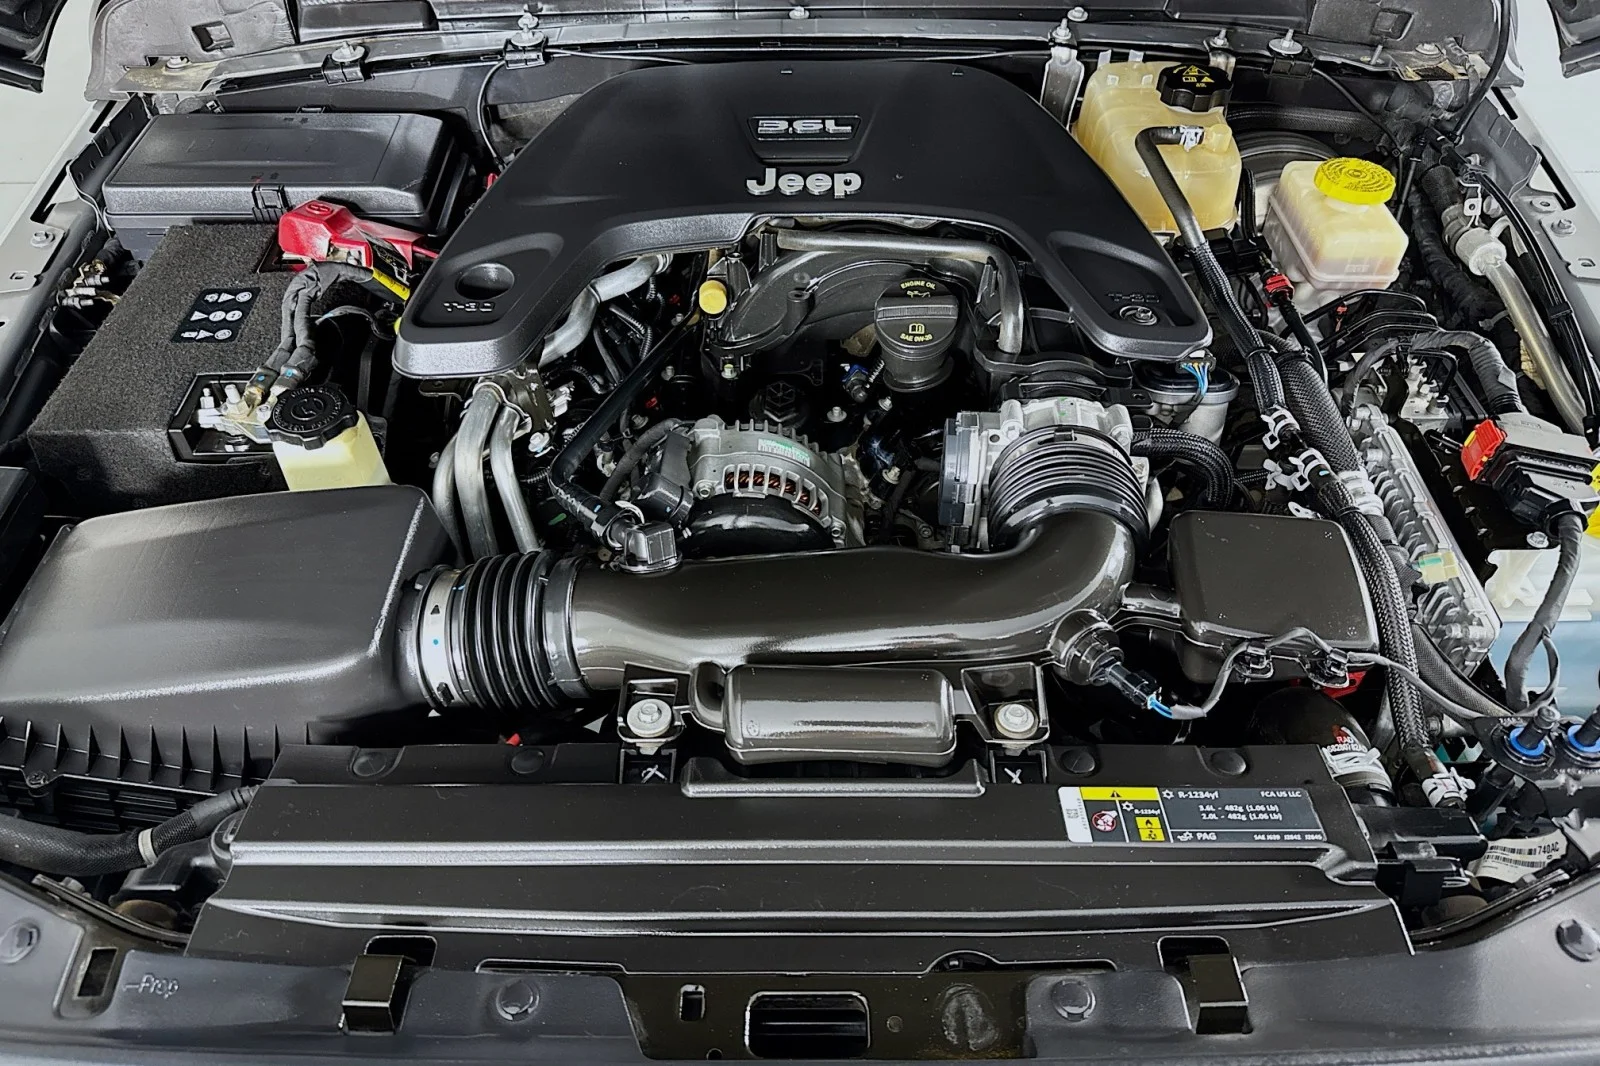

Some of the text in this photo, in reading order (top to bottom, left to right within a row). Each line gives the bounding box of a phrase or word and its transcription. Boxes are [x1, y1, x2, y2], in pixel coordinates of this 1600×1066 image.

[757, 119, 852, 134] 3.6L
[746, 167, 862, 199] Jeep
[900, 280, 936, 290] ENGINE OIL
[900, 333, 913, 342] SAE
[1178, 790, 1219, 800] R-1234yf
[1260, 790, 1302, 798] FCA US LLC
[1198, 804, 1216, 812] 3.6L
[1195, 832, 1218, 841] PAG
